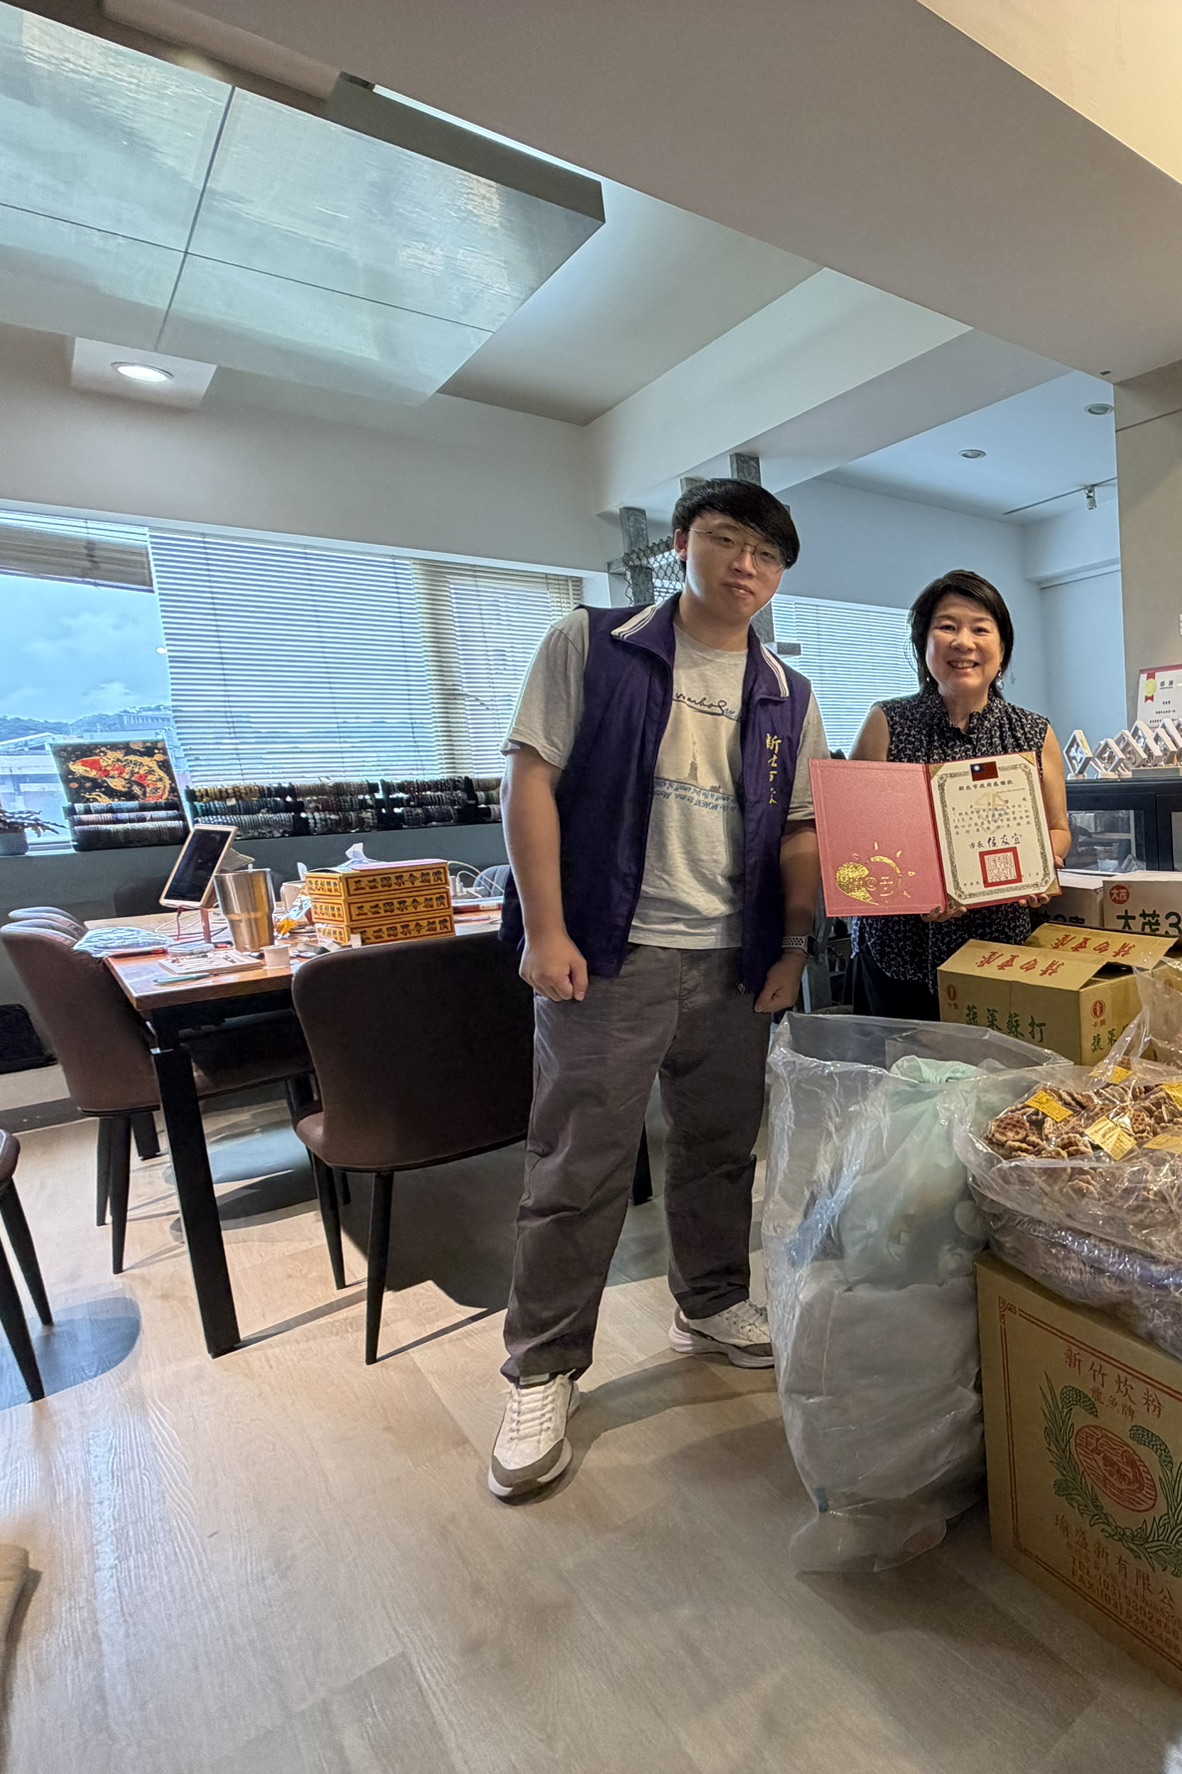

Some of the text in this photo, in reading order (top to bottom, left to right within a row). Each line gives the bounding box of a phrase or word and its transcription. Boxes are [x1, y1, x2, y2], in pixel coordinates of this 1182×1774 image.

[987, 833, 1023, 848] 侯友宜
[1110, 887, 1130, 900] 大茂
[1063, 1346, 1165, 1419] 新竹炊粉
